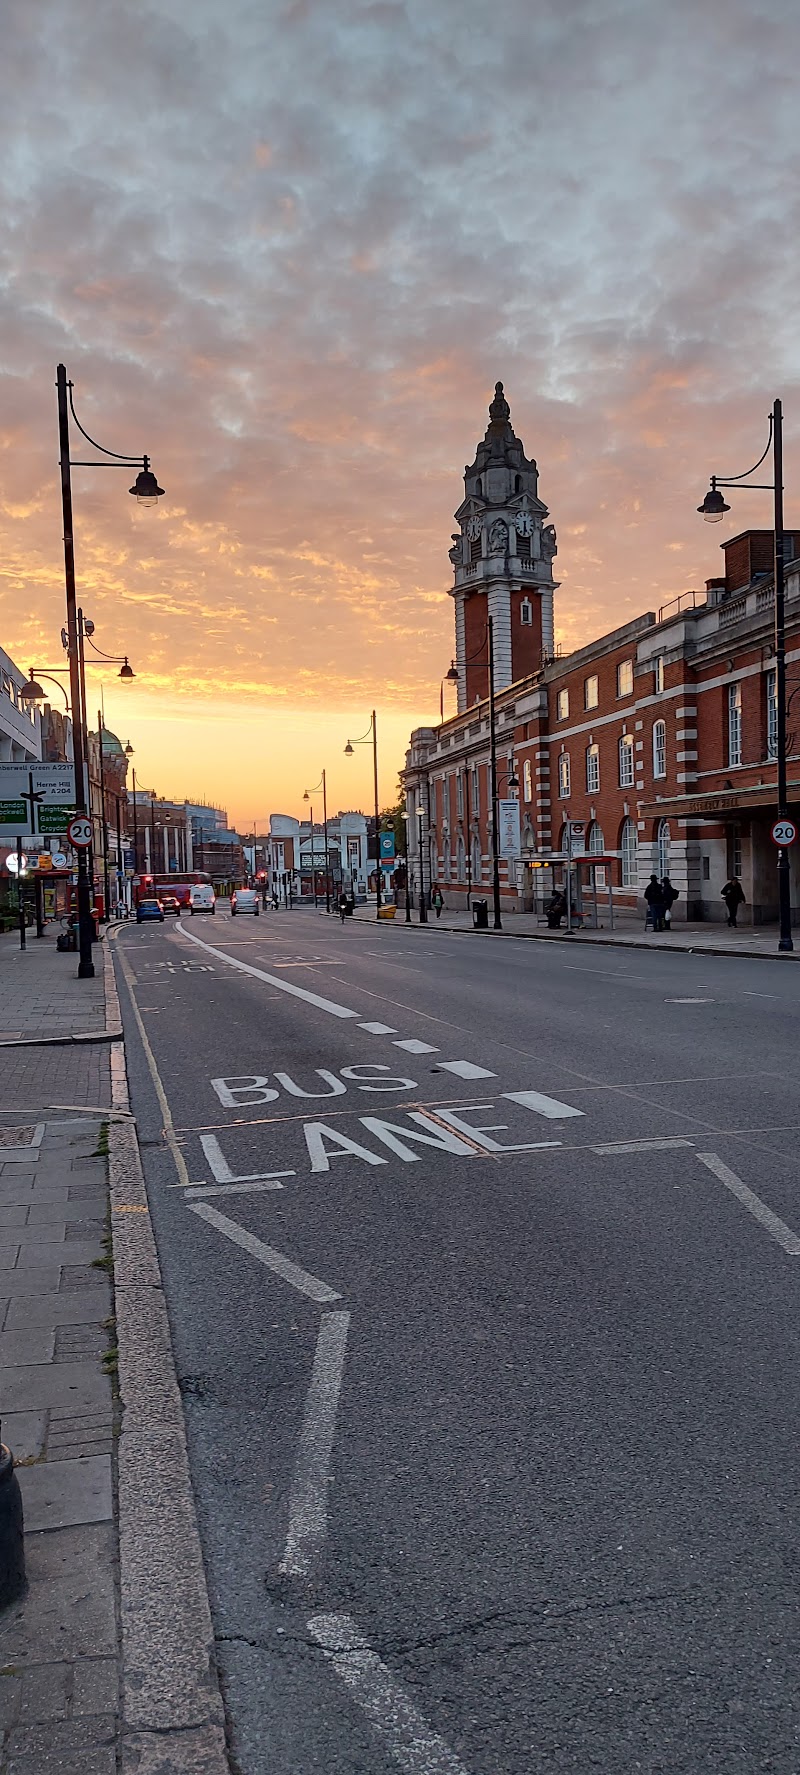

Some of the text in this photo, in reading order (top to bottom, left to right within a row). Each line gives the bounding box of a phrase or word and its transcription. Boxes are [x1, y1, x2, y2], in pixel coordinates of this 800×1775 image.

[72, 825, 92, 838] 20
[775, 827, 794, 839] 20
[144, 960, 211, 968] BUS
[210, 1064, 418, 1108] BUS
[200, 1105, 562, 1183] LANE
